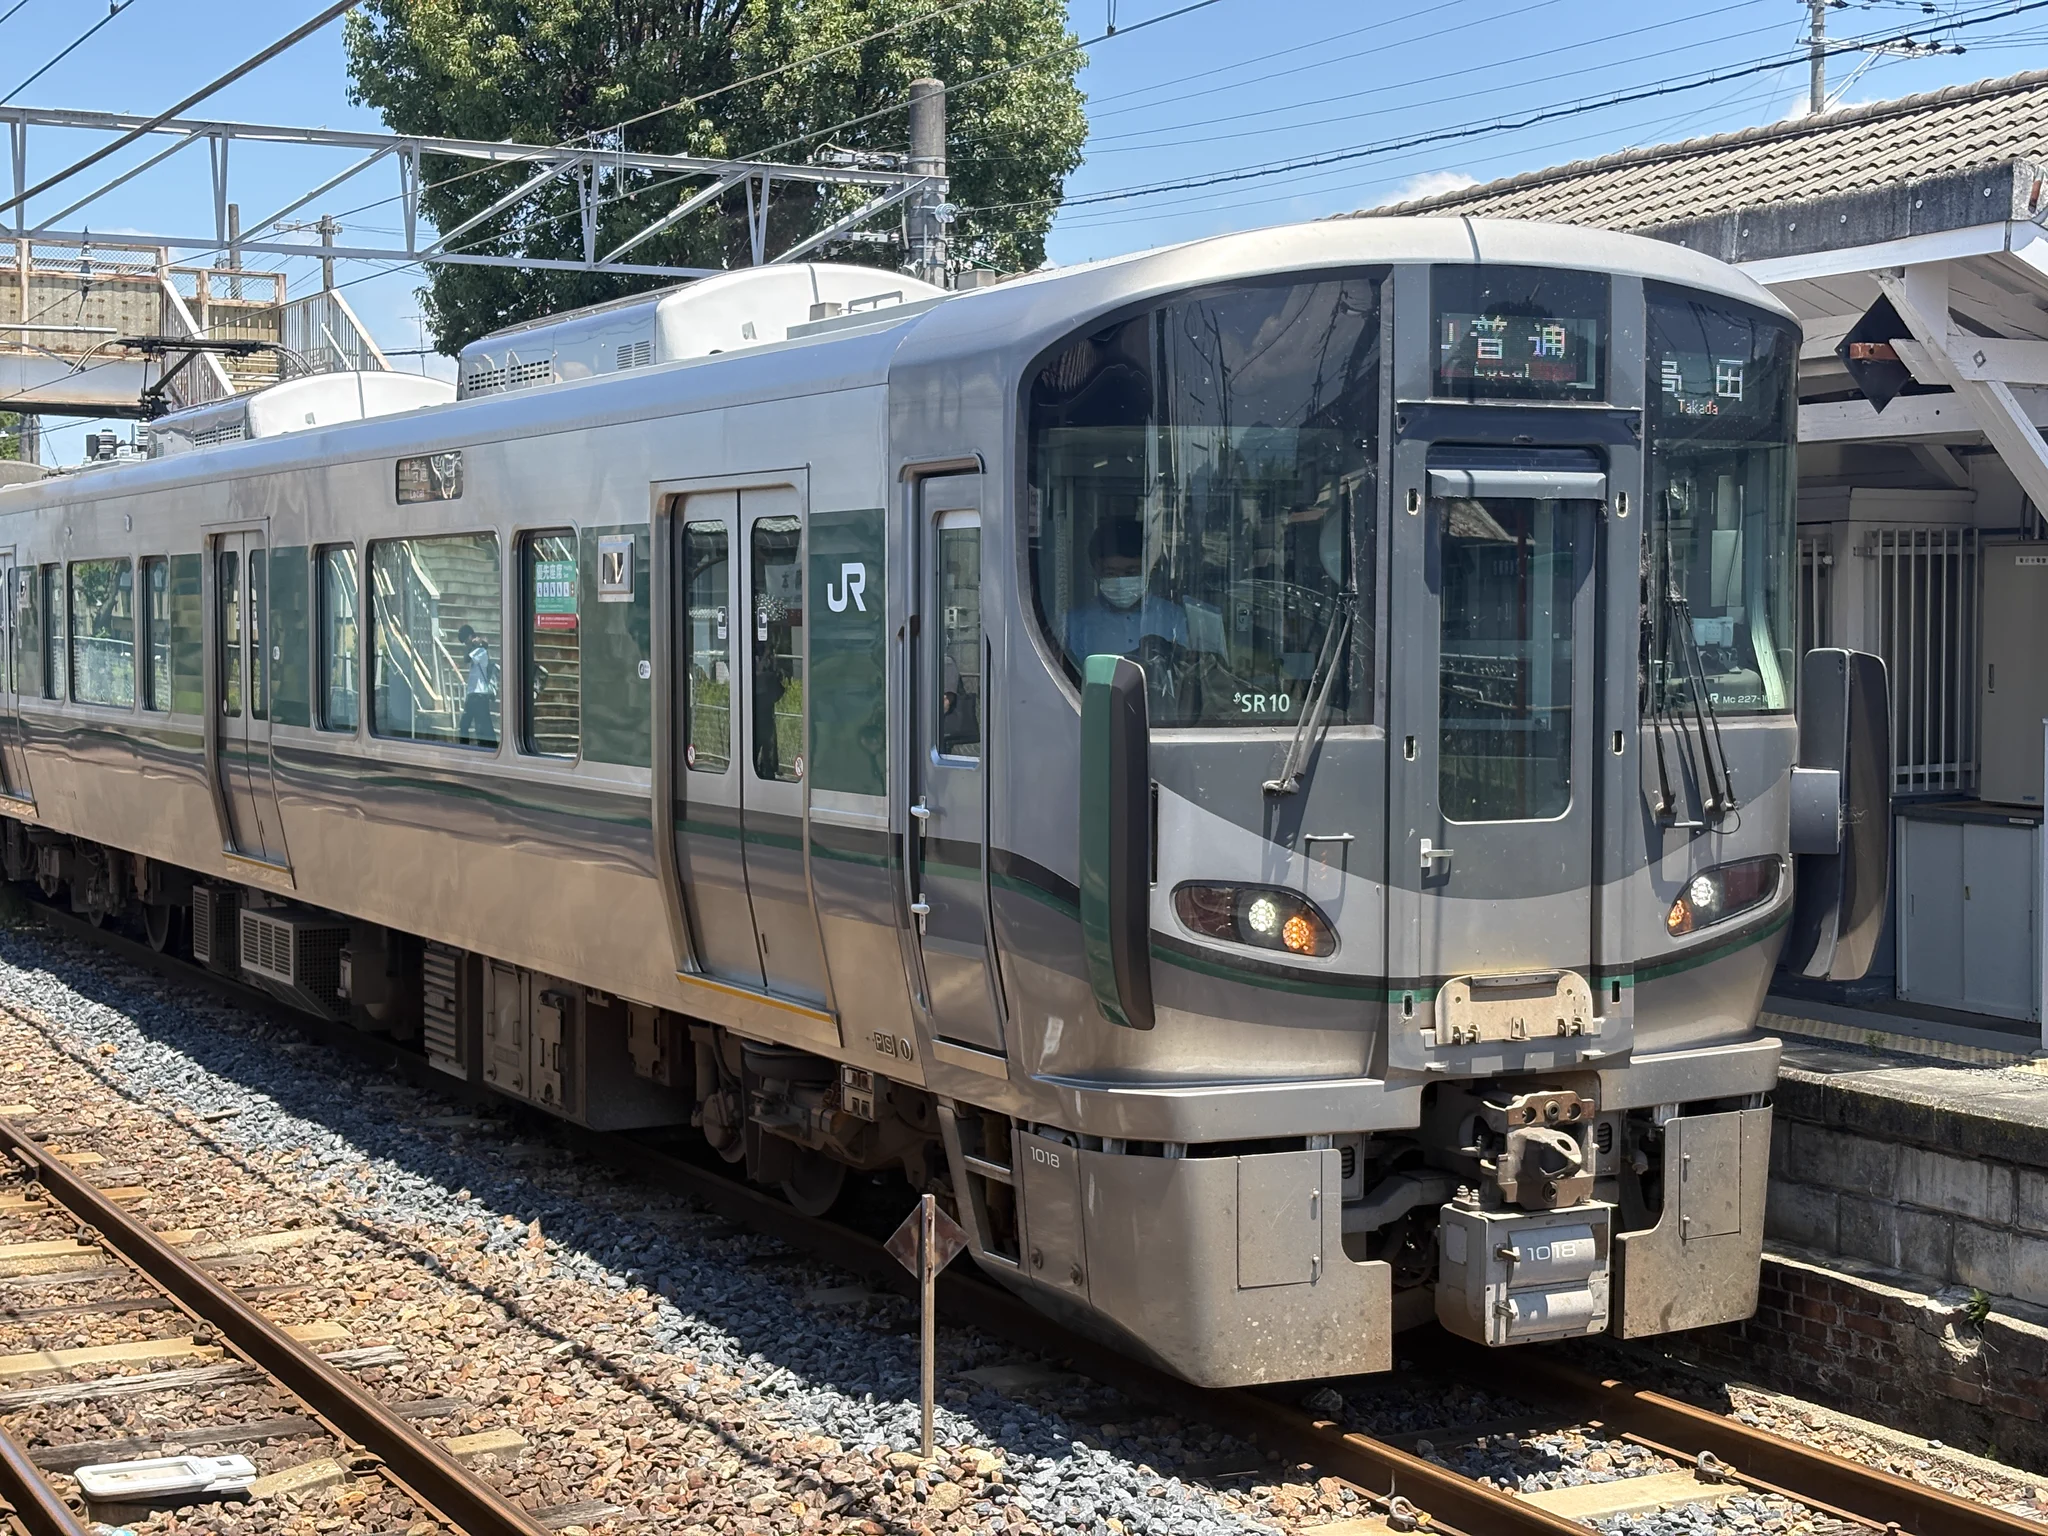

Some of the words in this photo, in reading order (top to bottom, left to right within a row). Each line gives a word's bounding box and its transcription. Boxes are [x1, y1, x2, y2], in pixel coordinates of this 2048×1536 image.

[1677, 398, 1719, 415] Takada
[827, 562, 867, 613] JR
[1030, 1146, 1060, 1168] 1018
[1527, 1242, 1577, 1261] 1018
